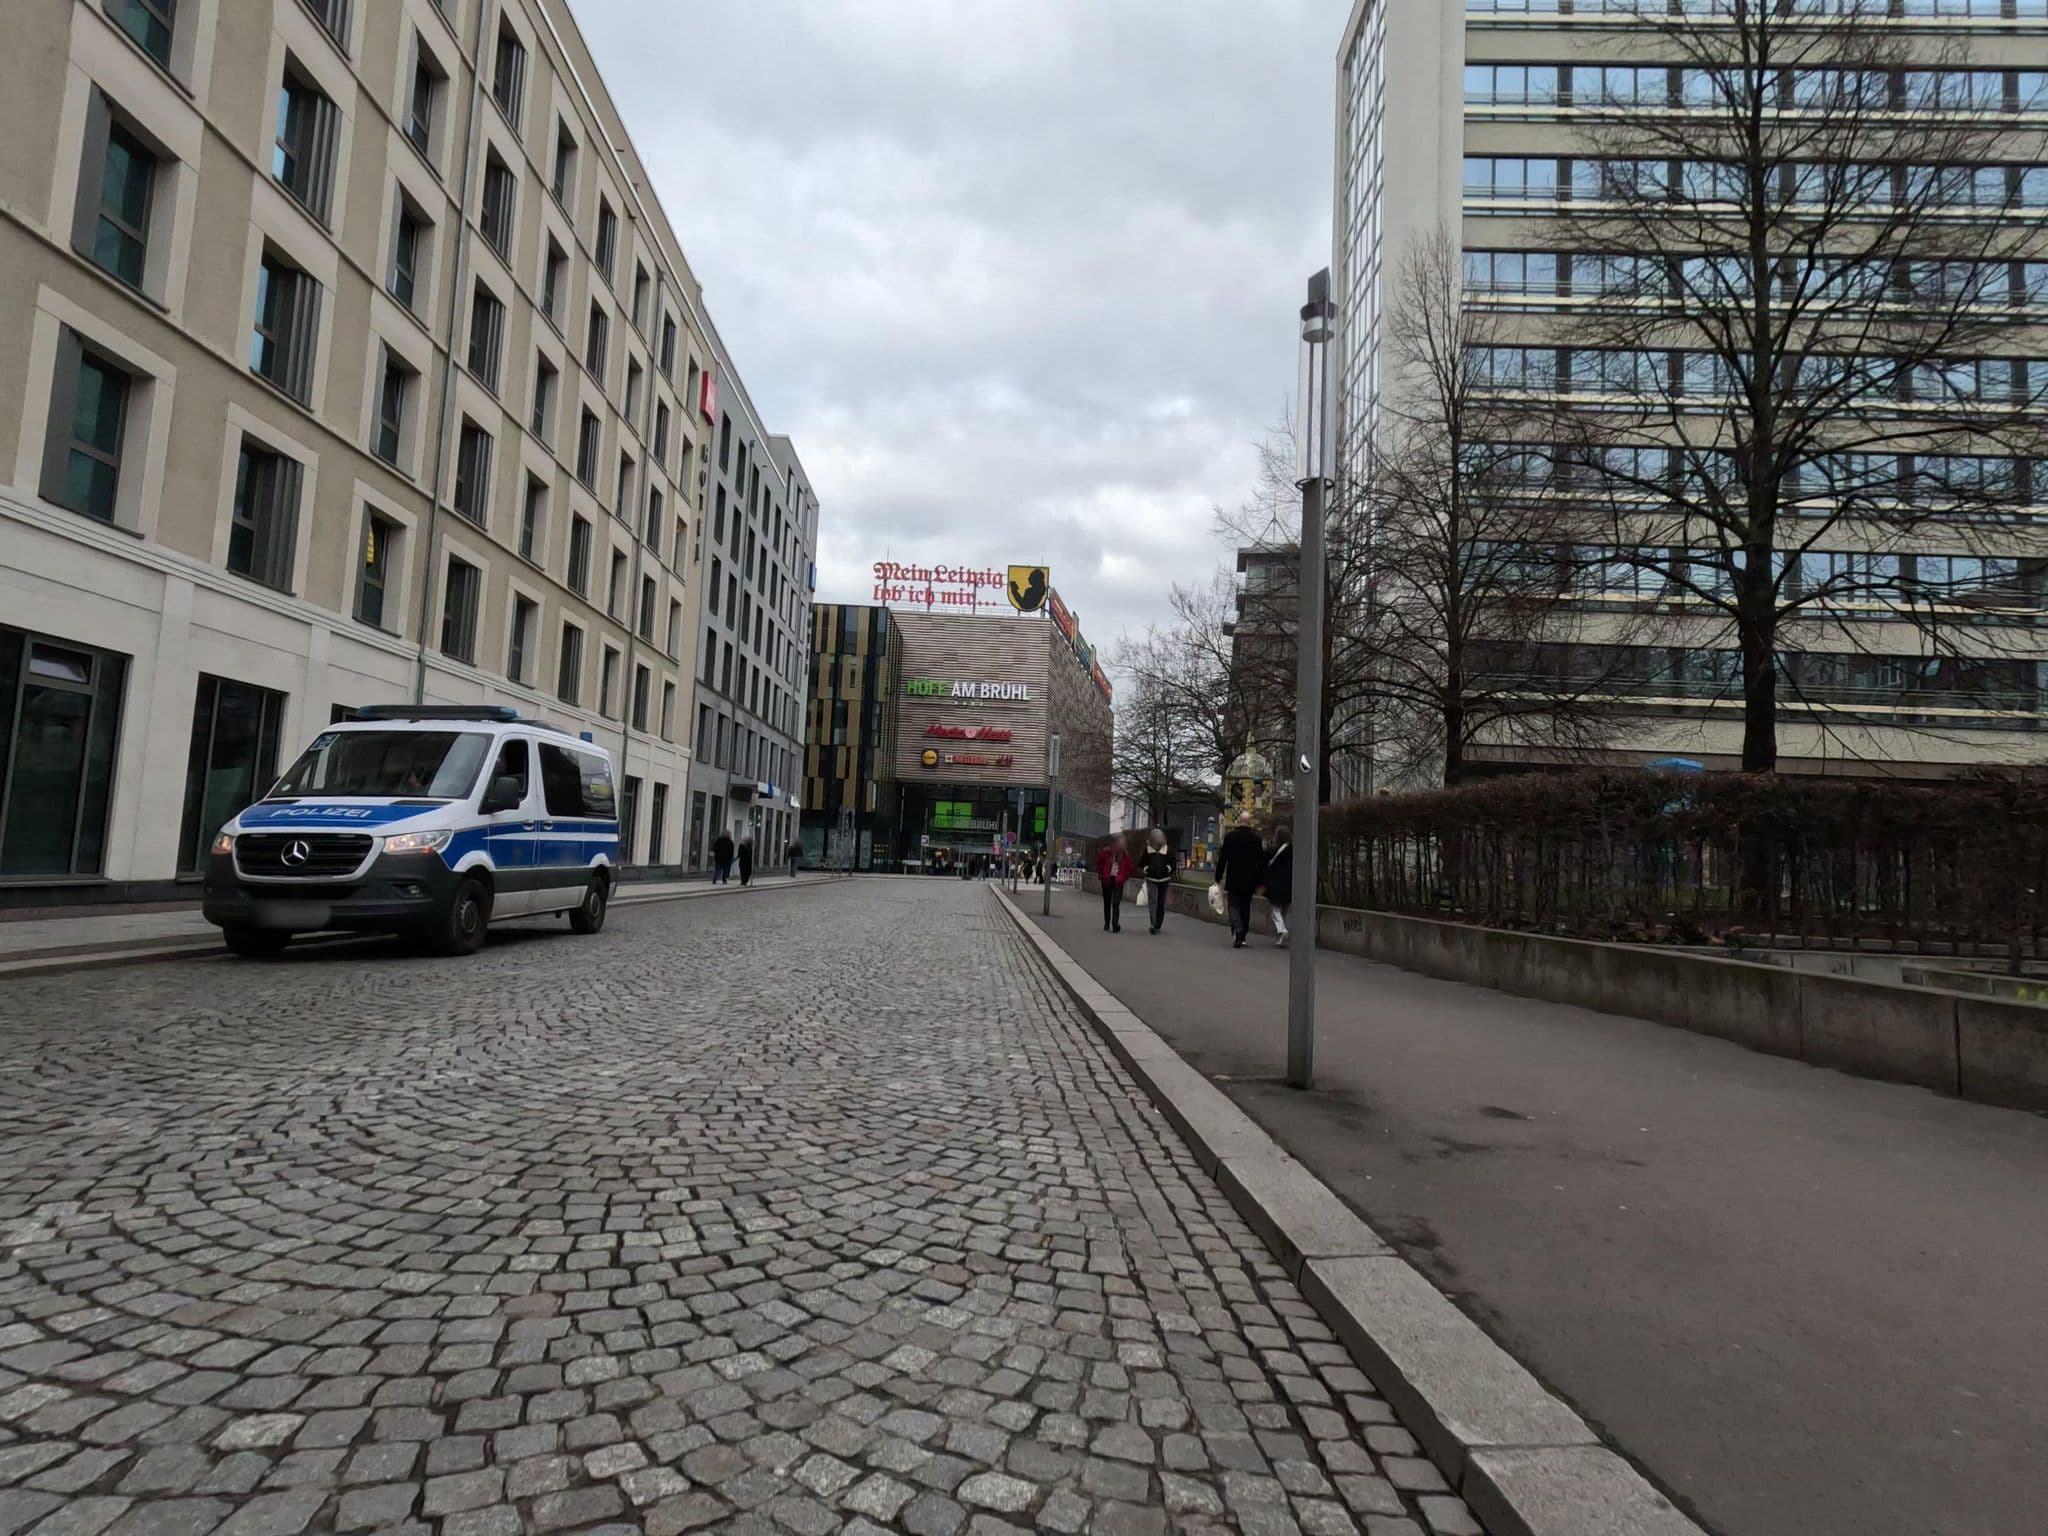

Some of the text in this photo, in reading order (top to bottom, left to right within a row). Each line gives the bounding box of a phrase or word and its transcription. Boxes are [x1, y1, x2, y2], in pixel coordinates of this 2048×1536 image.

[873, 562, 1004, 589] Mein Leipzig
[908, 585, 935, 607] ich
[907, 677, 1030, 701] HÖFE AM BRÜHL
[270, 808, 373, 818] POLIZEI
